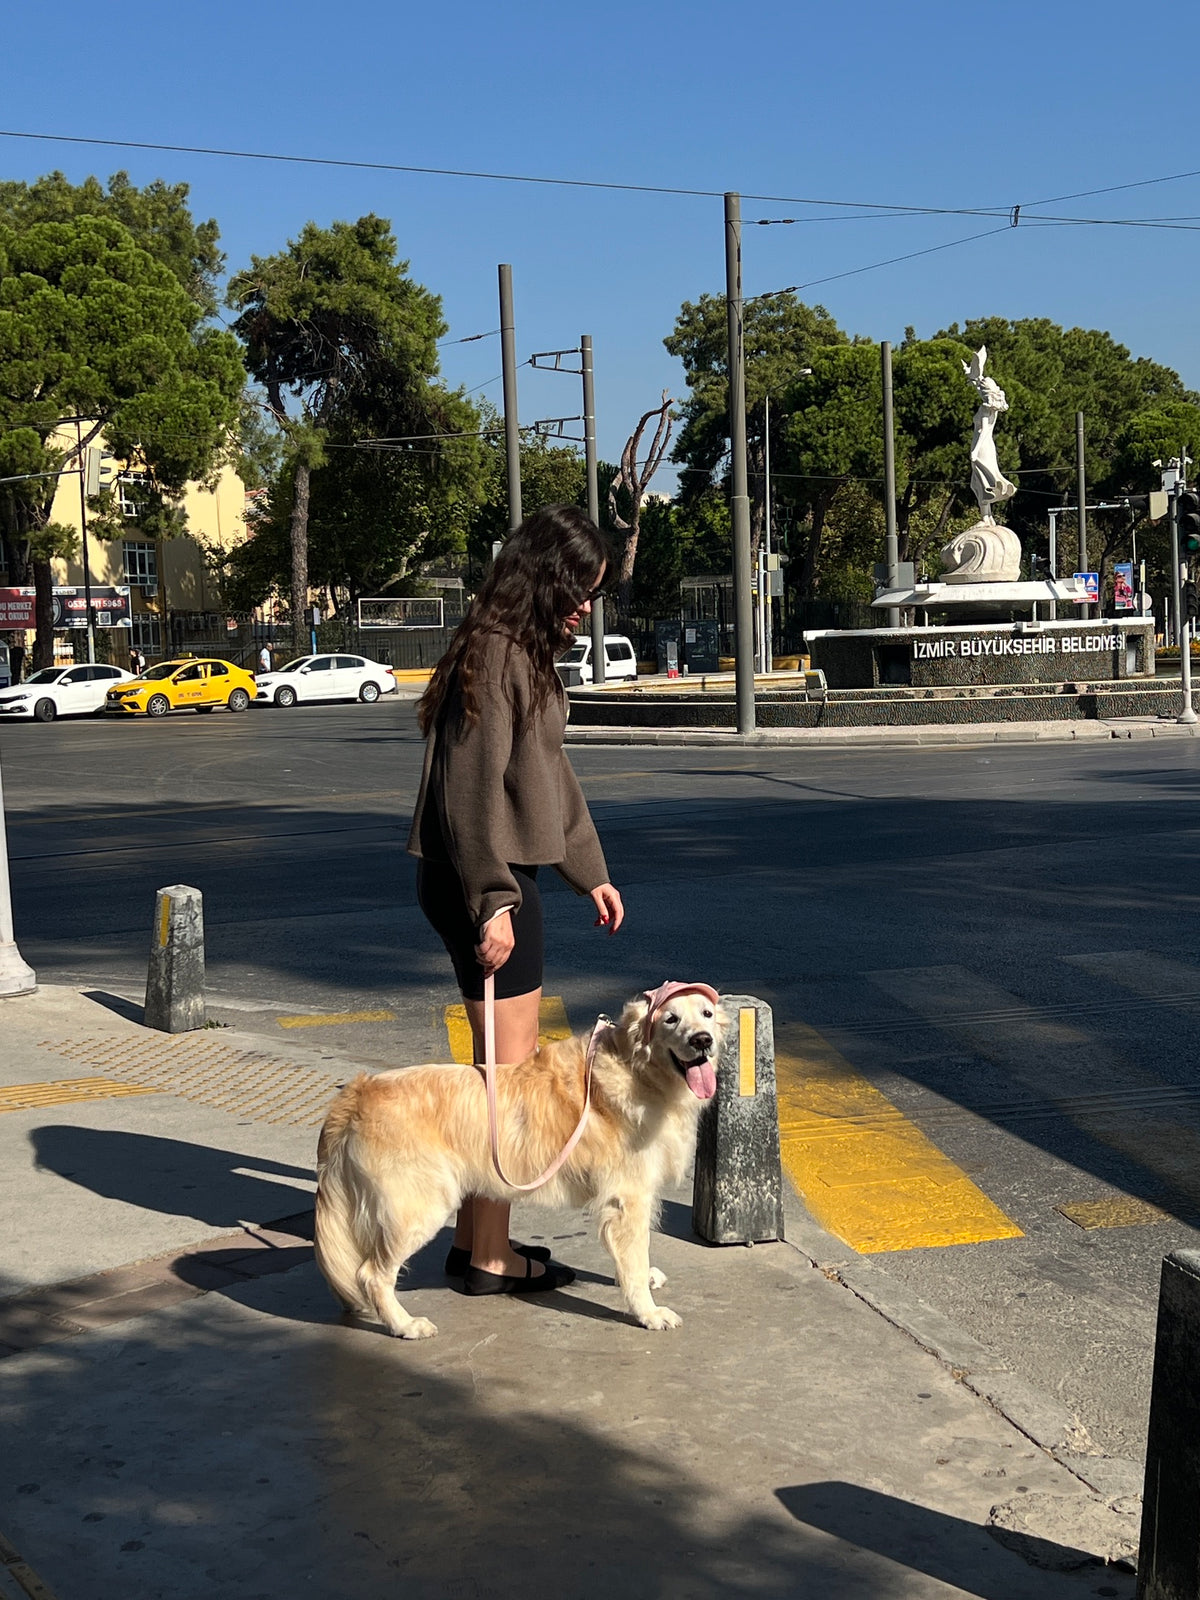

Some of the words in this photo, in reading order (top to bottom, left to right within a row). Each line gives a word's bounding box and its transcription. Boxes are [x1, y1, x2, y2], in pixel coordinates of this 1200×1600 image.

[8, 602, 32, 611] MERKEZ
[8, 612, 29, 621] OKULU
[913, 639, 957, 659] İZMİR
[960, 635, 1056, 657] BÜYÜKŞEHİR
[1061, 632, 1126, 653] BELEDİYESİ
